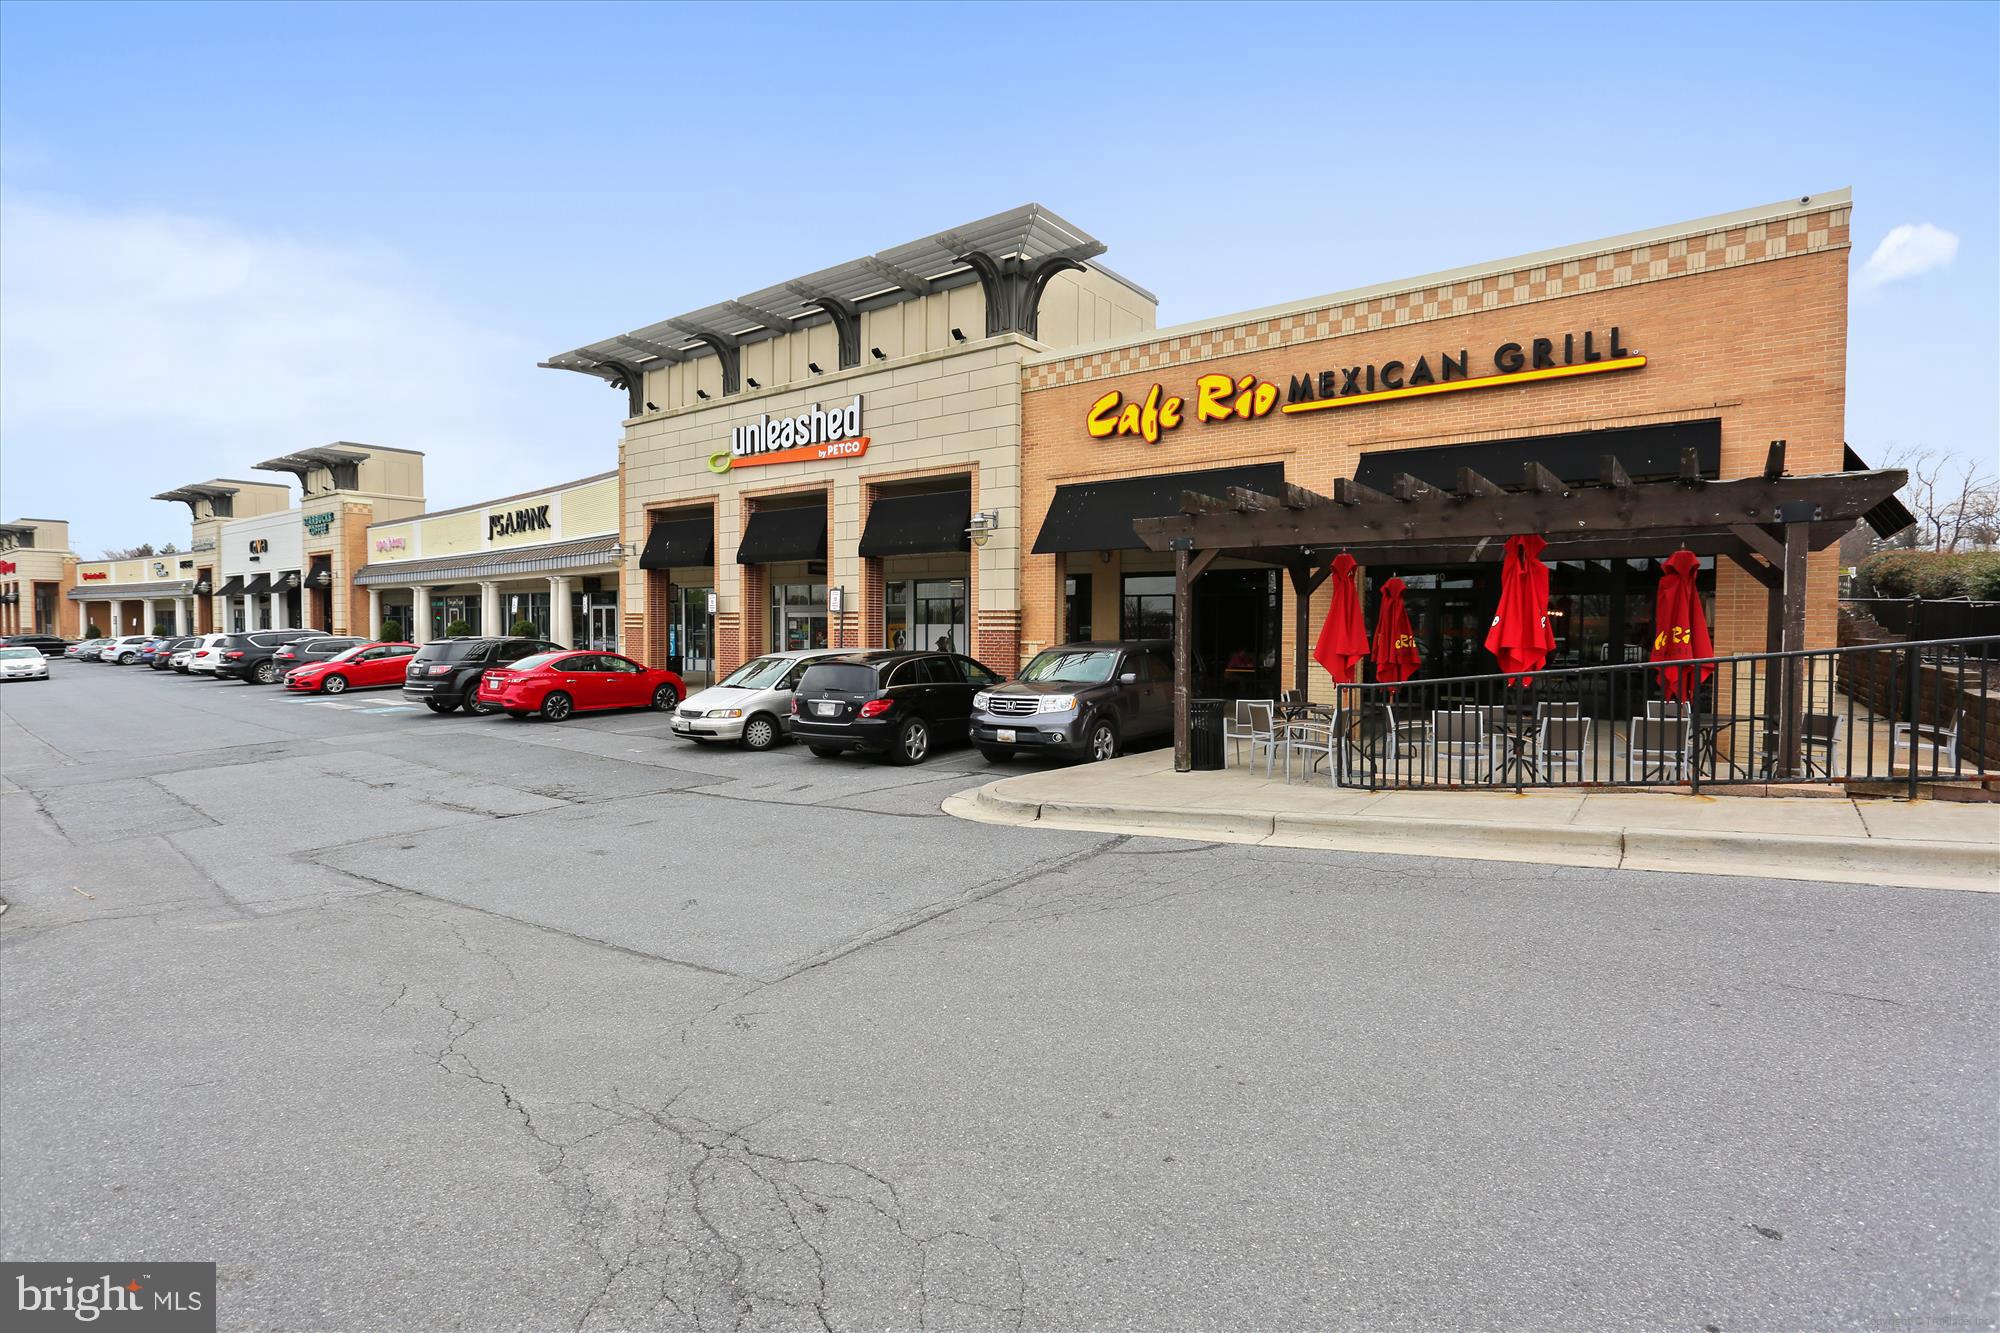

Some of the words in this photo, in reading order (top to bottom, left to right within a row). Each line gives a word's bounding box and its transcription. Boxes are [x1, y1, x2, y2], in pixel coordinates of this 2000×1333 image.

[1087, 383, 1185, 444] Cafe
[1287, 349, 1469, 402] MEXICAN
[1494, 326, 1628, 372] GRILL
[732, 394, 865, 456] unleashed
[818, 449, 827, 458] by
[827, 441, 860, 456] PETCO
